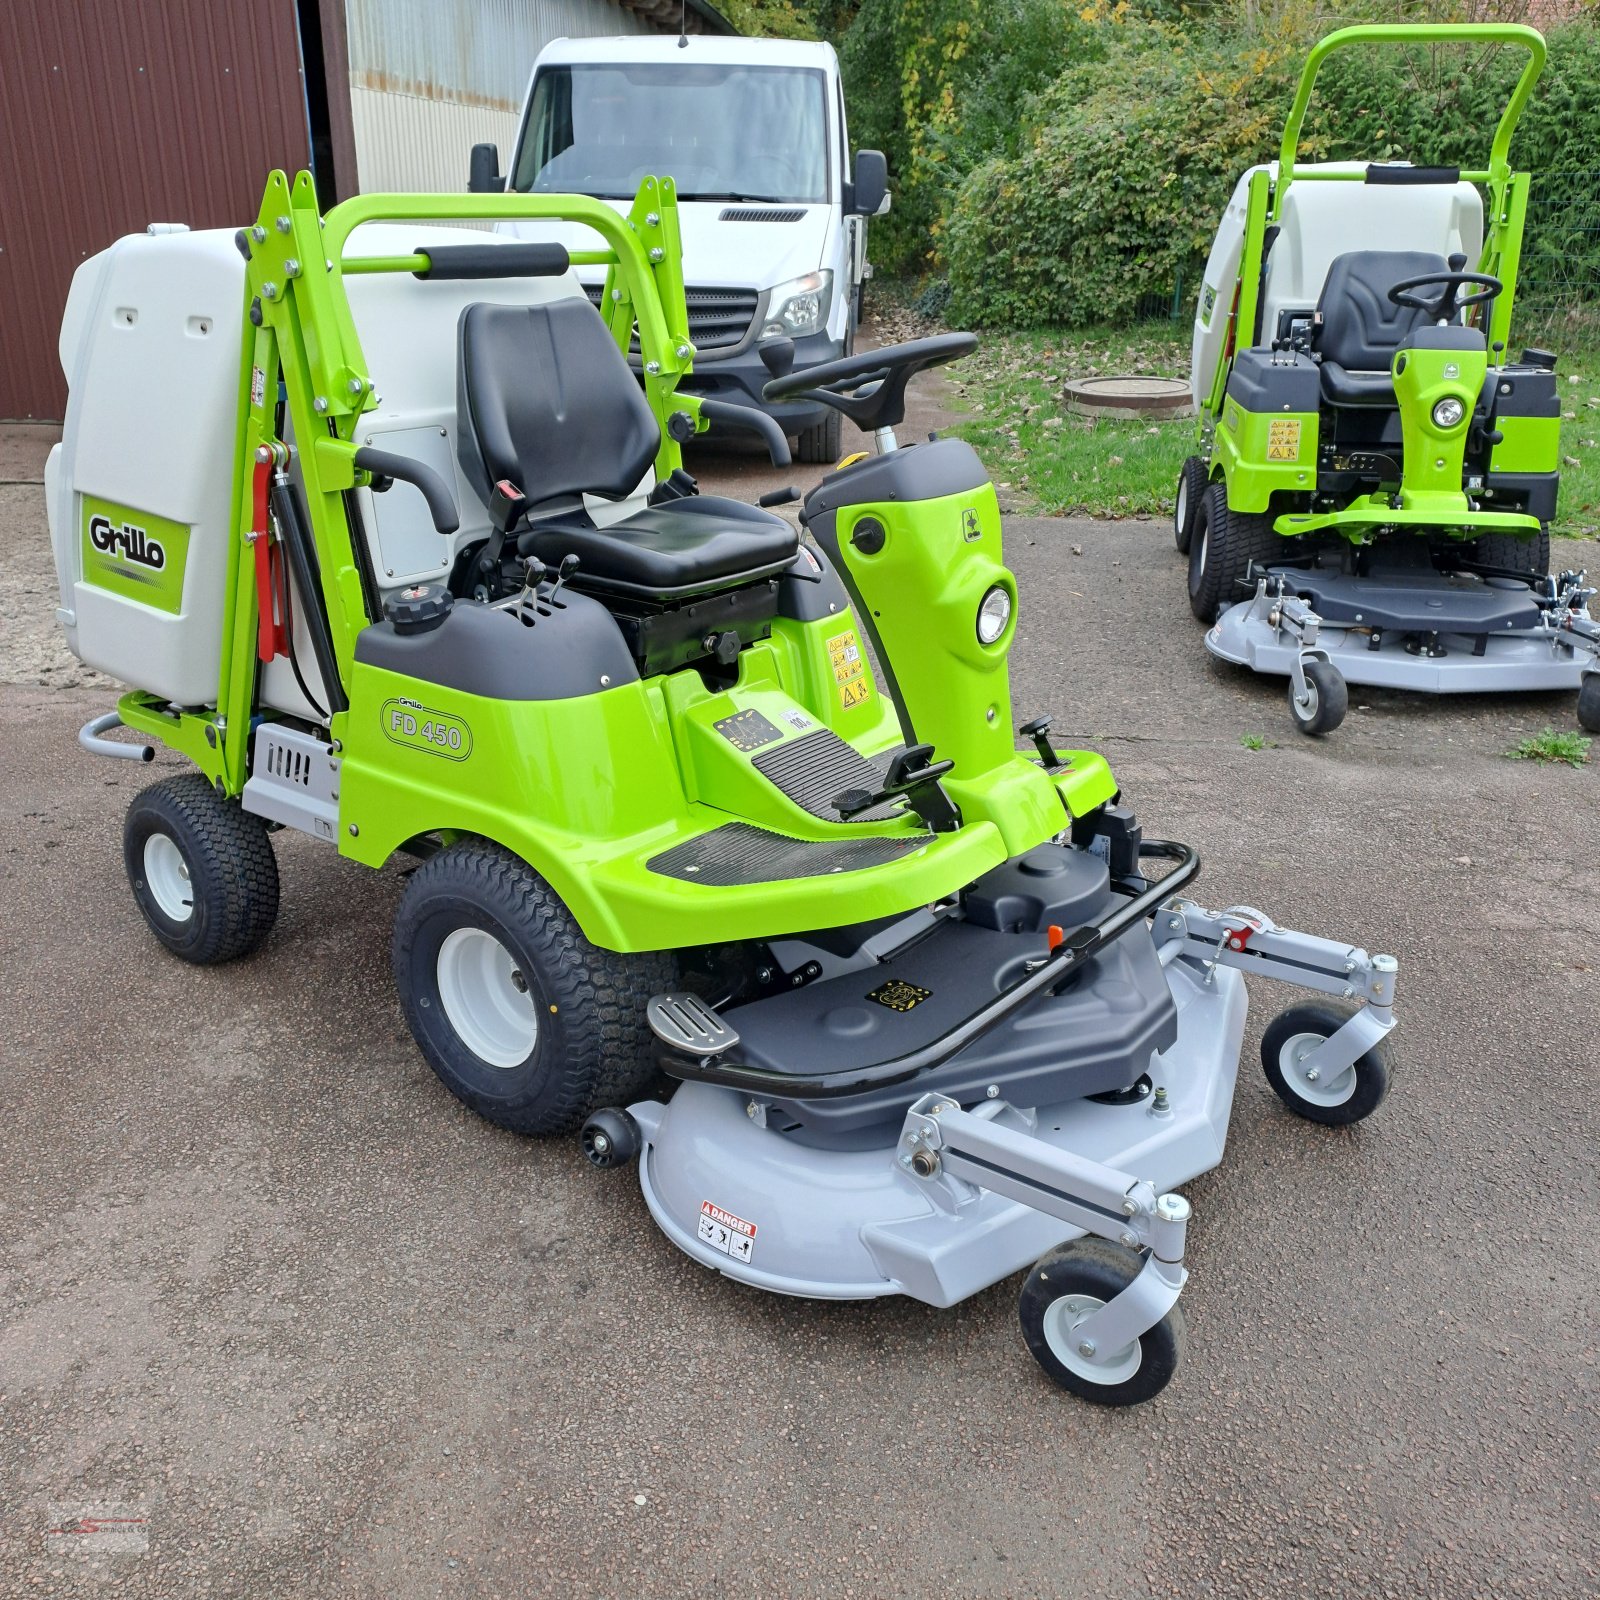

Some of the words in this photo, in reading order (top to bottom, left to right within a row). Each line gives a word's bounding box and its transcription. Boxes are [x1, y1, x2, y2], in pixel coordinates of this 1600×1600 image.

[90, 516, 165, 570] Grillo
[399, 697, 423, 710] Grillo
[391, 709, 417, 736] FD
[421, 720, 462, 750] 450
[710, 1206, 752, 1235] DANGER
